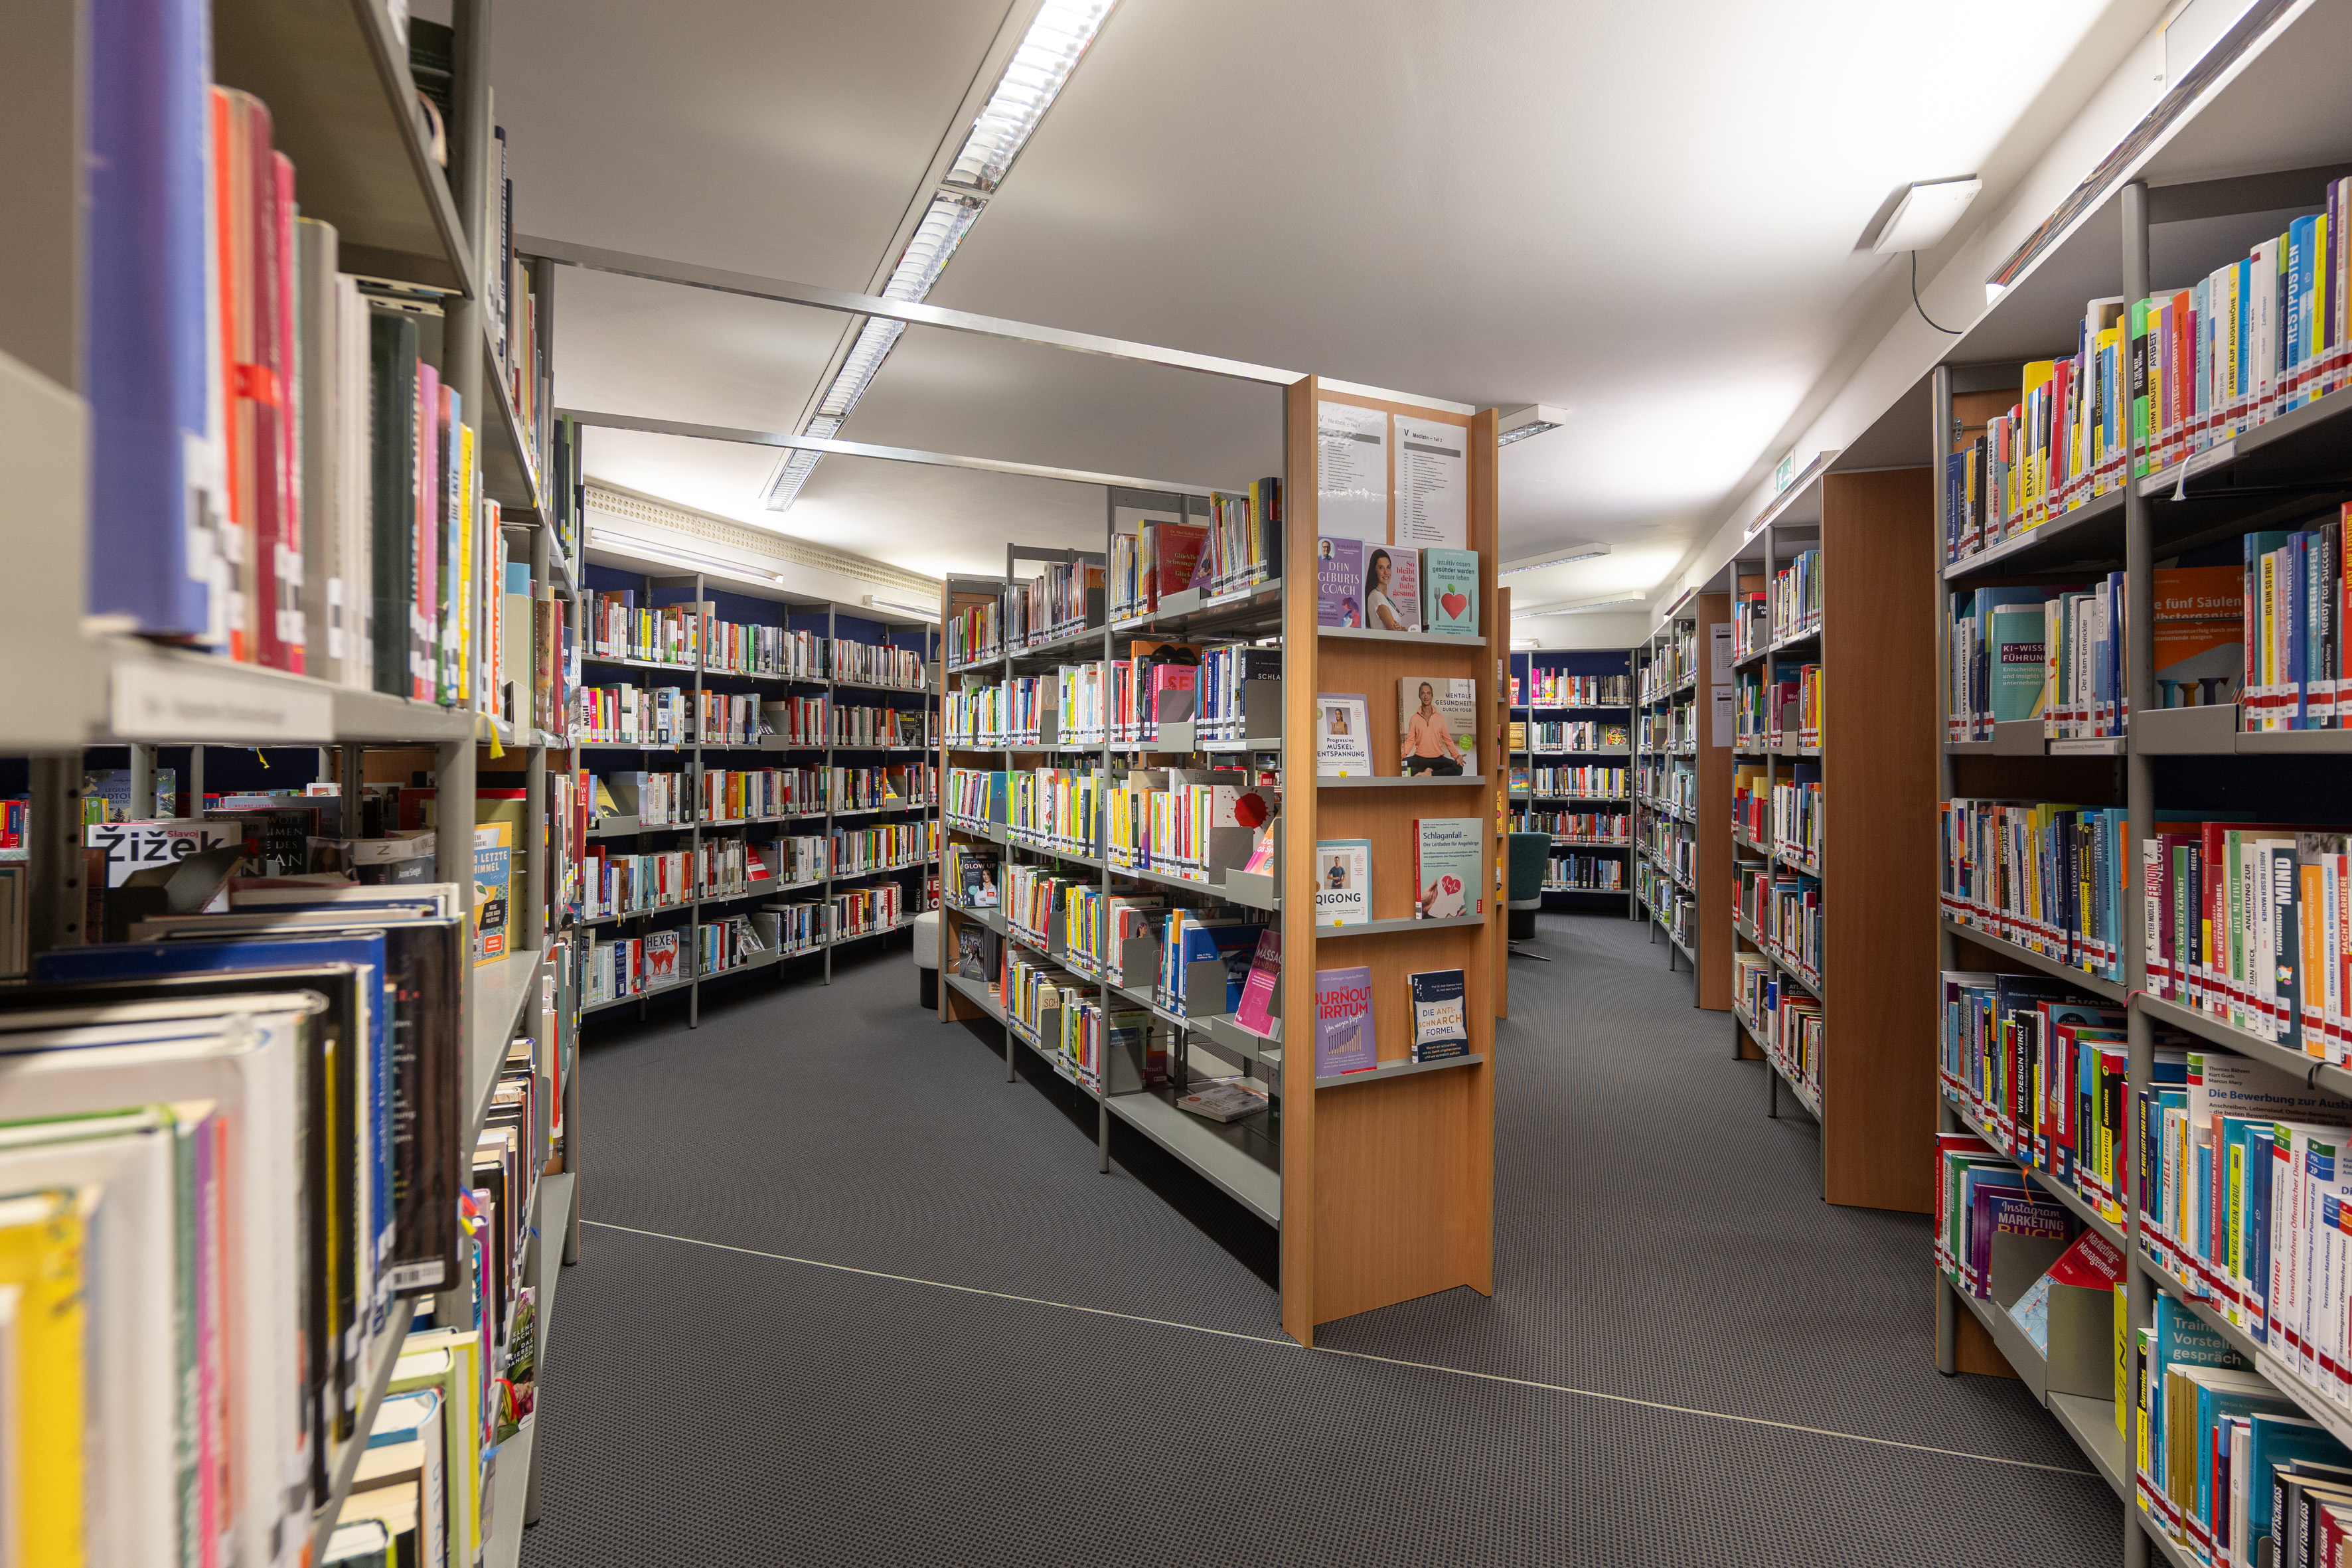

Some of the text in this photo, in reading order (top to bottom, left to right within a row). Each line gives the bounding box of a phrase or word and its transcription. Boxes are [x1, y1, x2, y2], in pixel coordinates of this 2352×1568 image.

[2288, 244, 2299, 343] RESTPOSTEN
[1329, 562, 1349, 572] DEIN
[1318, 572, 1360, 584] GEBURTS
[1322, 584, 1355, 595] COACH
[2166, 596, 2241, 609] fünf Säulen
[268, 816, 302, 824] WOLF
[1423, 831, 1462, 840] Schlaganfall
[377, 846, 390, 855] Z
[481, 850, 507, 863] LETZTE
[398, 866, 422, 879] Anne Siegel
[474, 862, 500, 874] HIMMEL
[2148, 863, 2158, 898] FEINDIN
[2274, 858, 2291, 905] MIND
[1316, 893, 1361, 905] QIGONG
[647, 934, 678, 947] HEXEN
[1316, 986, 1371, 1005] BURNOUT
[1320, 1002, 1368, 1019] IRRTUM
[1419, 1014, 1462, 1028] SCHNARCH
[1426, 1026, 1455, 1036] FORMEL
[2209, 1089, 2227, 1098] Die
[2230, 1091, 2295, 1106] Bewerbung
[2319, 1099, 2352, 1109] Ausbi
[2209, 1103, 2248, 1111] Anschreiben,
[2310, 1154, 2319, 1163] POL
[2310, 1166, 2318, 1175] 2P
[2001, 1201, 2061, 1218] Instagram
[2290, 1178, 2299, 1229] Öffentlicher
[1998, 1212, 2063, 1231] MARKETING
[2086, 1232, 2120, 1263] Marketing-
[2077, 1241, 2118, 1280] Management
[521, 1338, 533, 1348] DAS
[510, 1344, 533, 1361] LIEBEN
[2173, 1348, 2241, 1365] gespräch
[507, 1350, 533, 1369] DANACH
[2273, 1484, 2282, 1547] LUFTSCHLOSS
[2299, 1500, 2309, 1563] LUFTSCHLOSS
